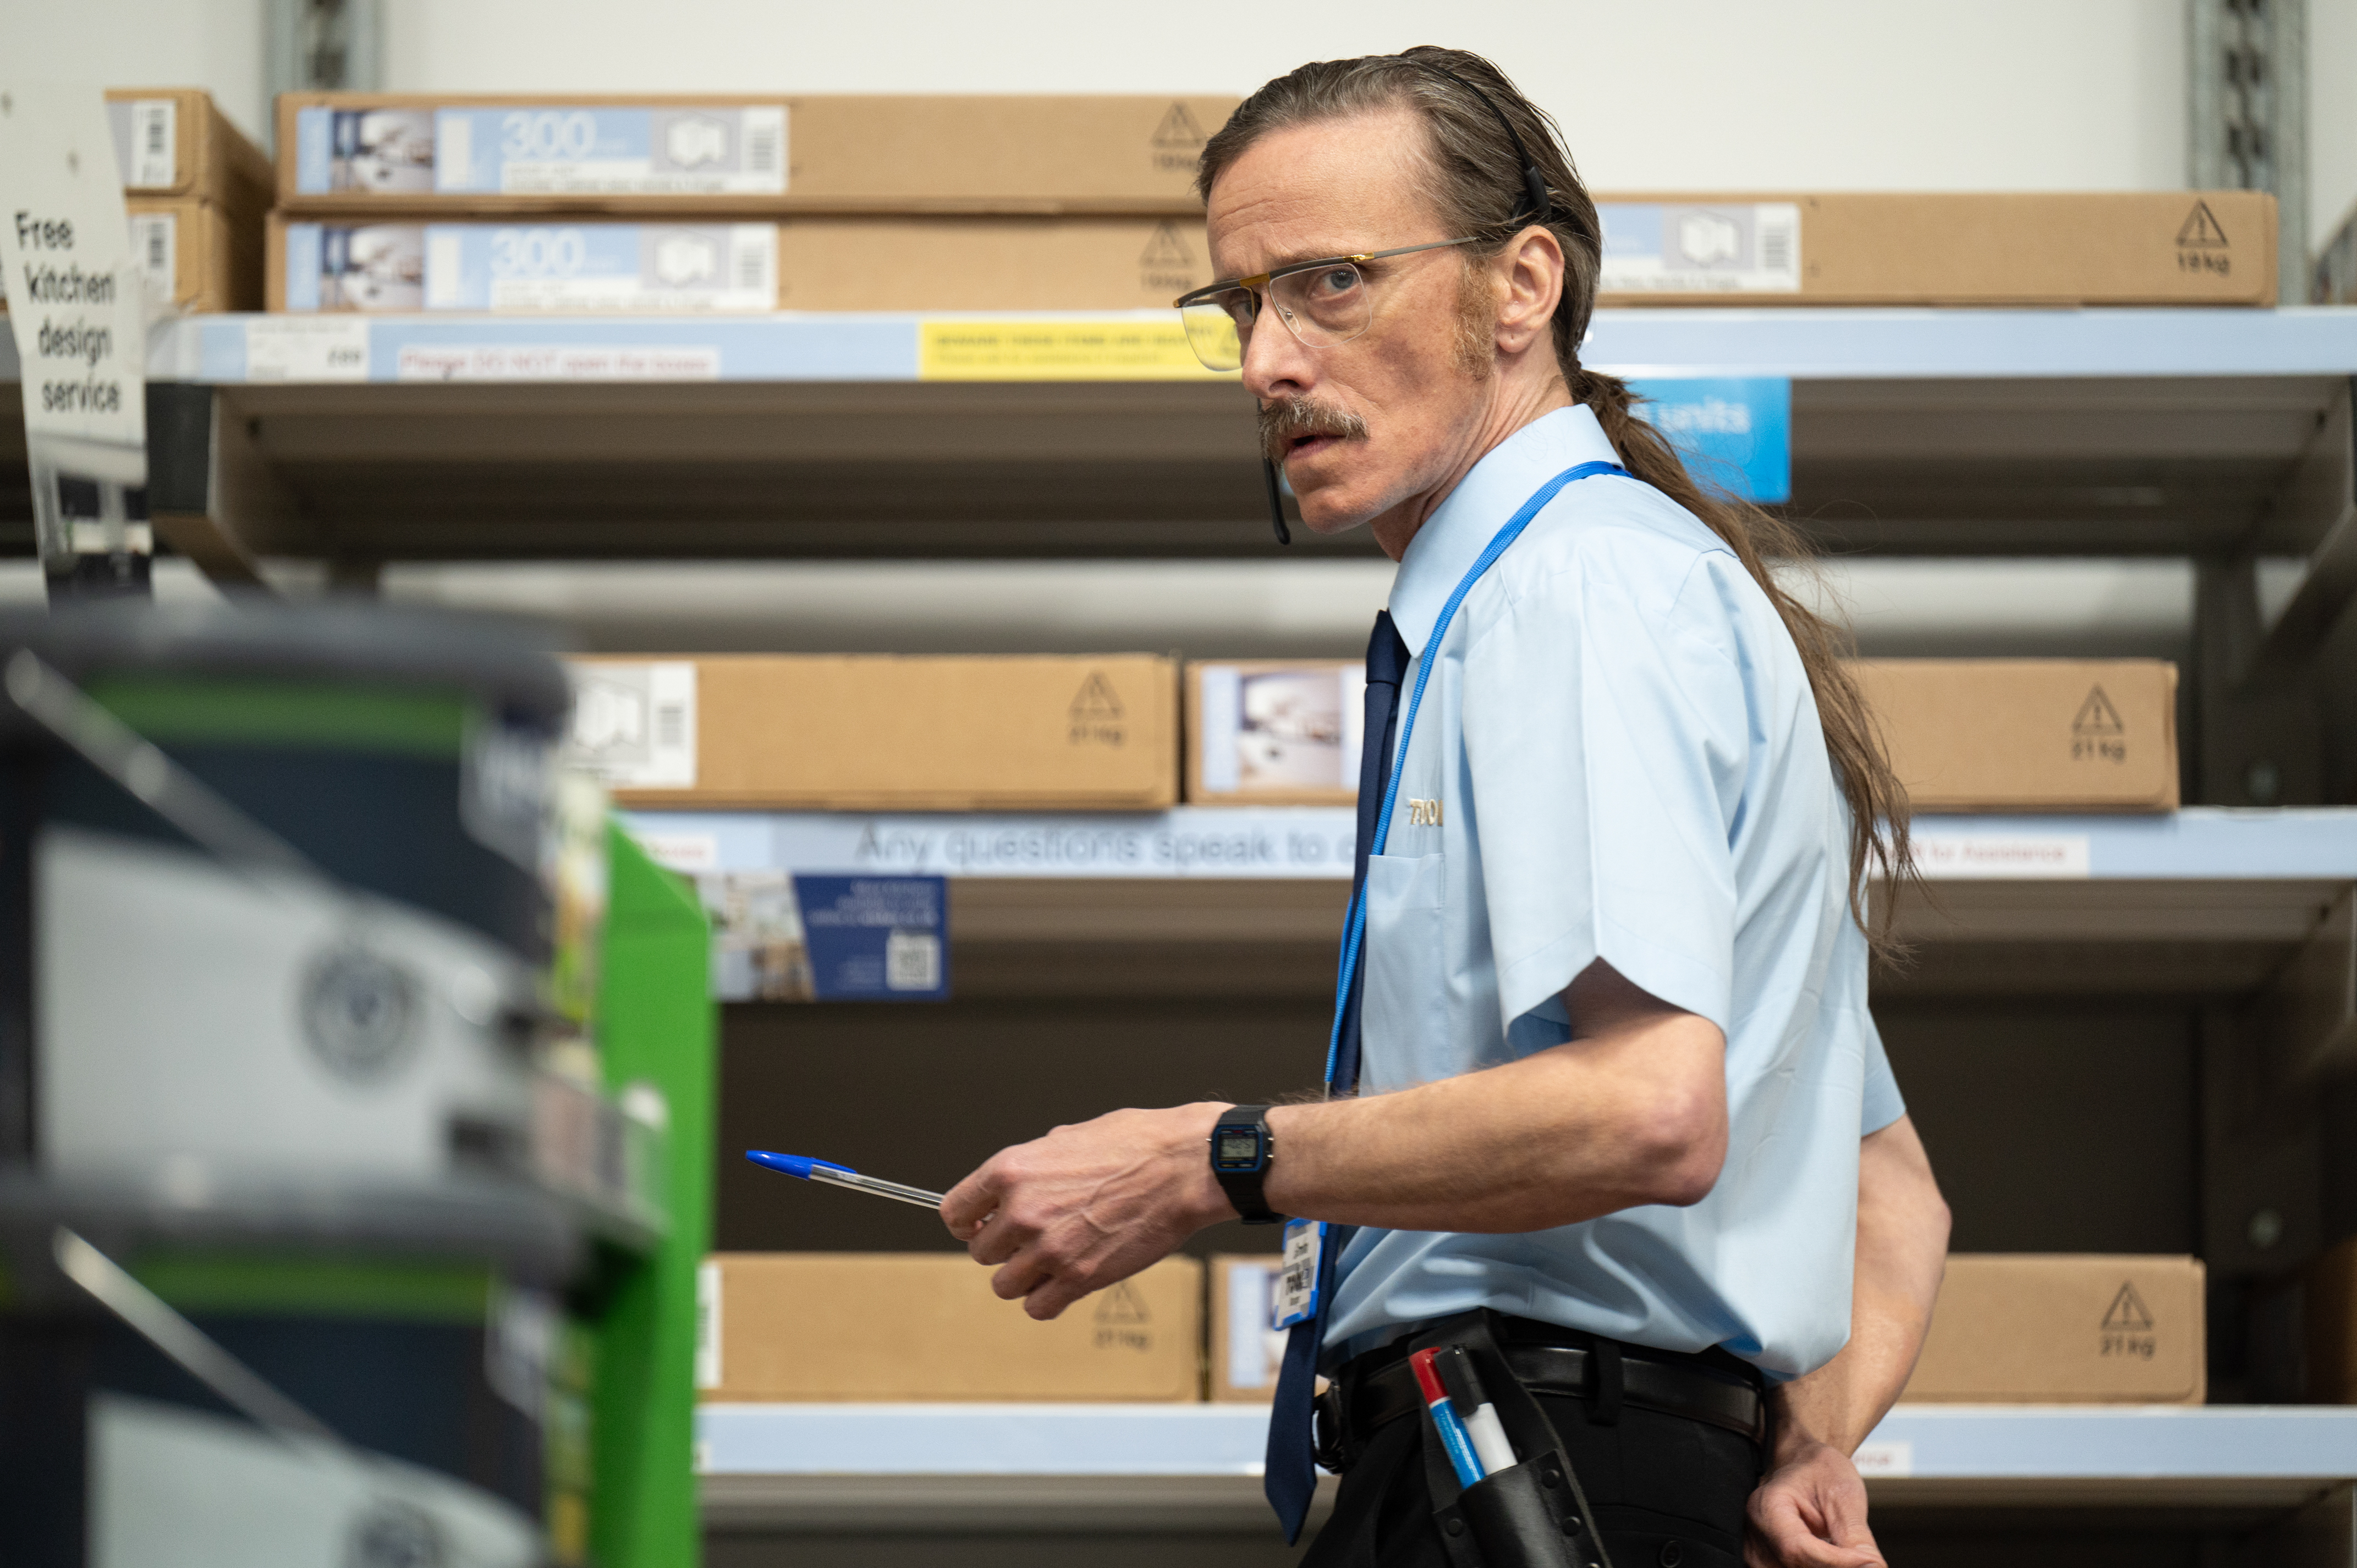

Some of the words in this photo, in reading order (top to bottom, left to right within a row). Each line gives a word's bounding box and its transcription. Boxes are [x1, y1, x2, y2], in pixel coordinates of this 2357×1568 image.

[15, 211, 74, 249] Free
[24, 262, 115, 303] kitchen
[38, 315, 112, 367] design
[42, 371, 120, 412] service
[854, 825, 927, 876] Any
[945, 827, 1138, 876] questions
[1153, 826, 1276, 876] speak
[1288, 827, 1330, 865] to
